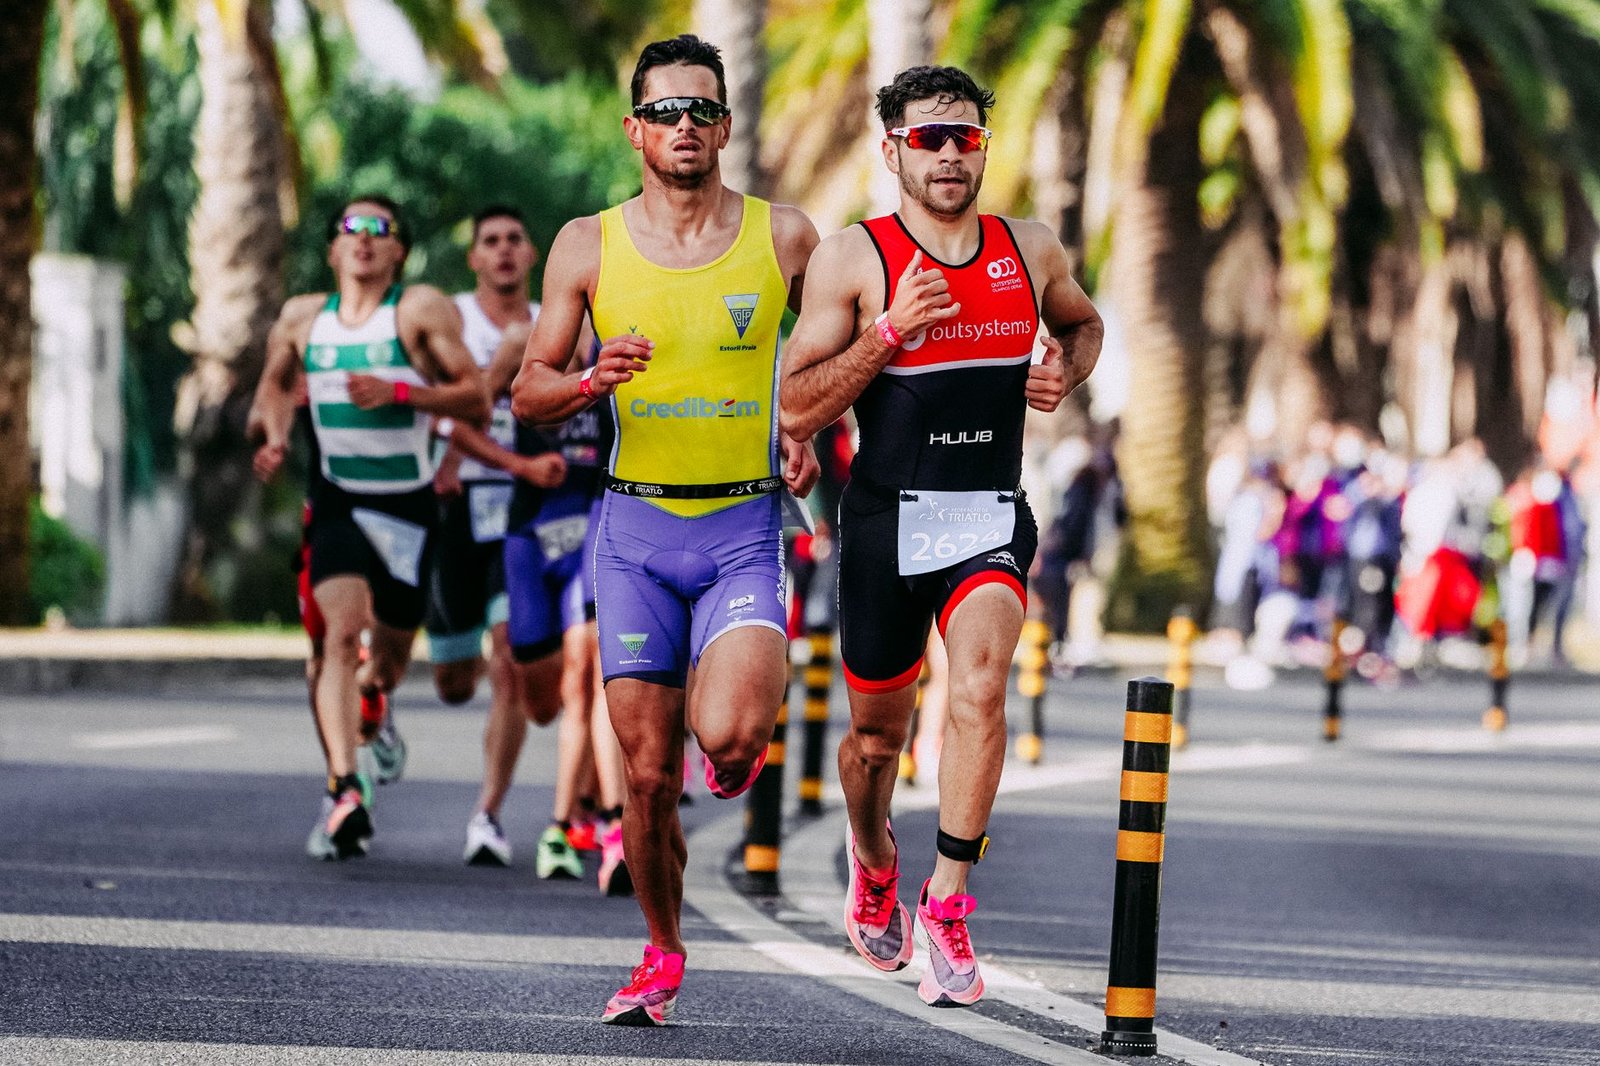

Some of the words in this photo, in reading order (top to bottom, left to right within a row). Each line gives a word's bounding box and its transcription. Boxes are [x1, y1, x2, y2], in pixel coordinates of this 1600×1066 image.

[931, 319, 1031, 342] outsystems
[630, 397, 760, 418] Credibom
[929, 430, 993, 445] HUUB
[634, 486, 664, 495] TRIATLO
[948, 512, 992, 522] TRIATLO
[910, 528, 1005, 561] 2624
